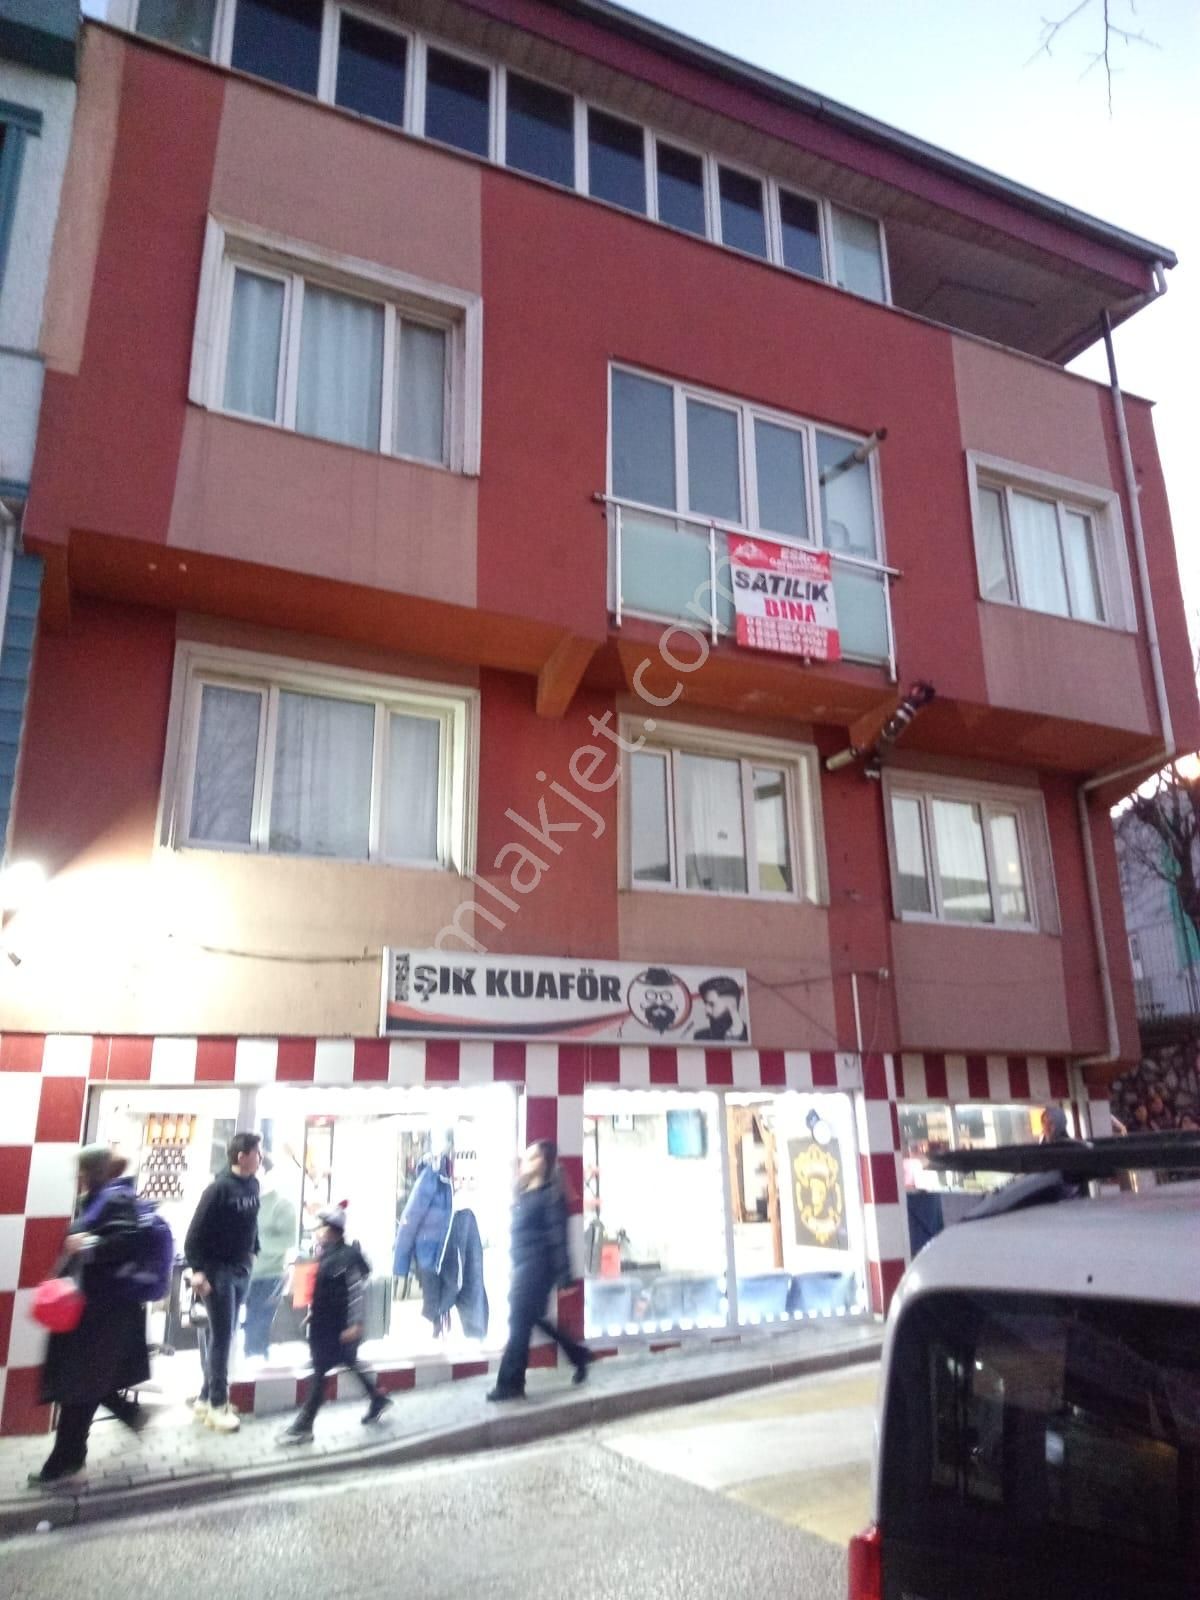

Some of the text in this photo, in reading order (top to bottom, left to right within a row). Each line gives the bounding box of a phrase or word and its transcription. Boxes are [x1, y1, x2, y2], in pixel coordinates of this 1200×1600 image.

[735, 571, 829, 602] SATILIK
[414, 964, 477, 1002] ŞIK
[485, 967, 622, 1003] KUAFÖR
